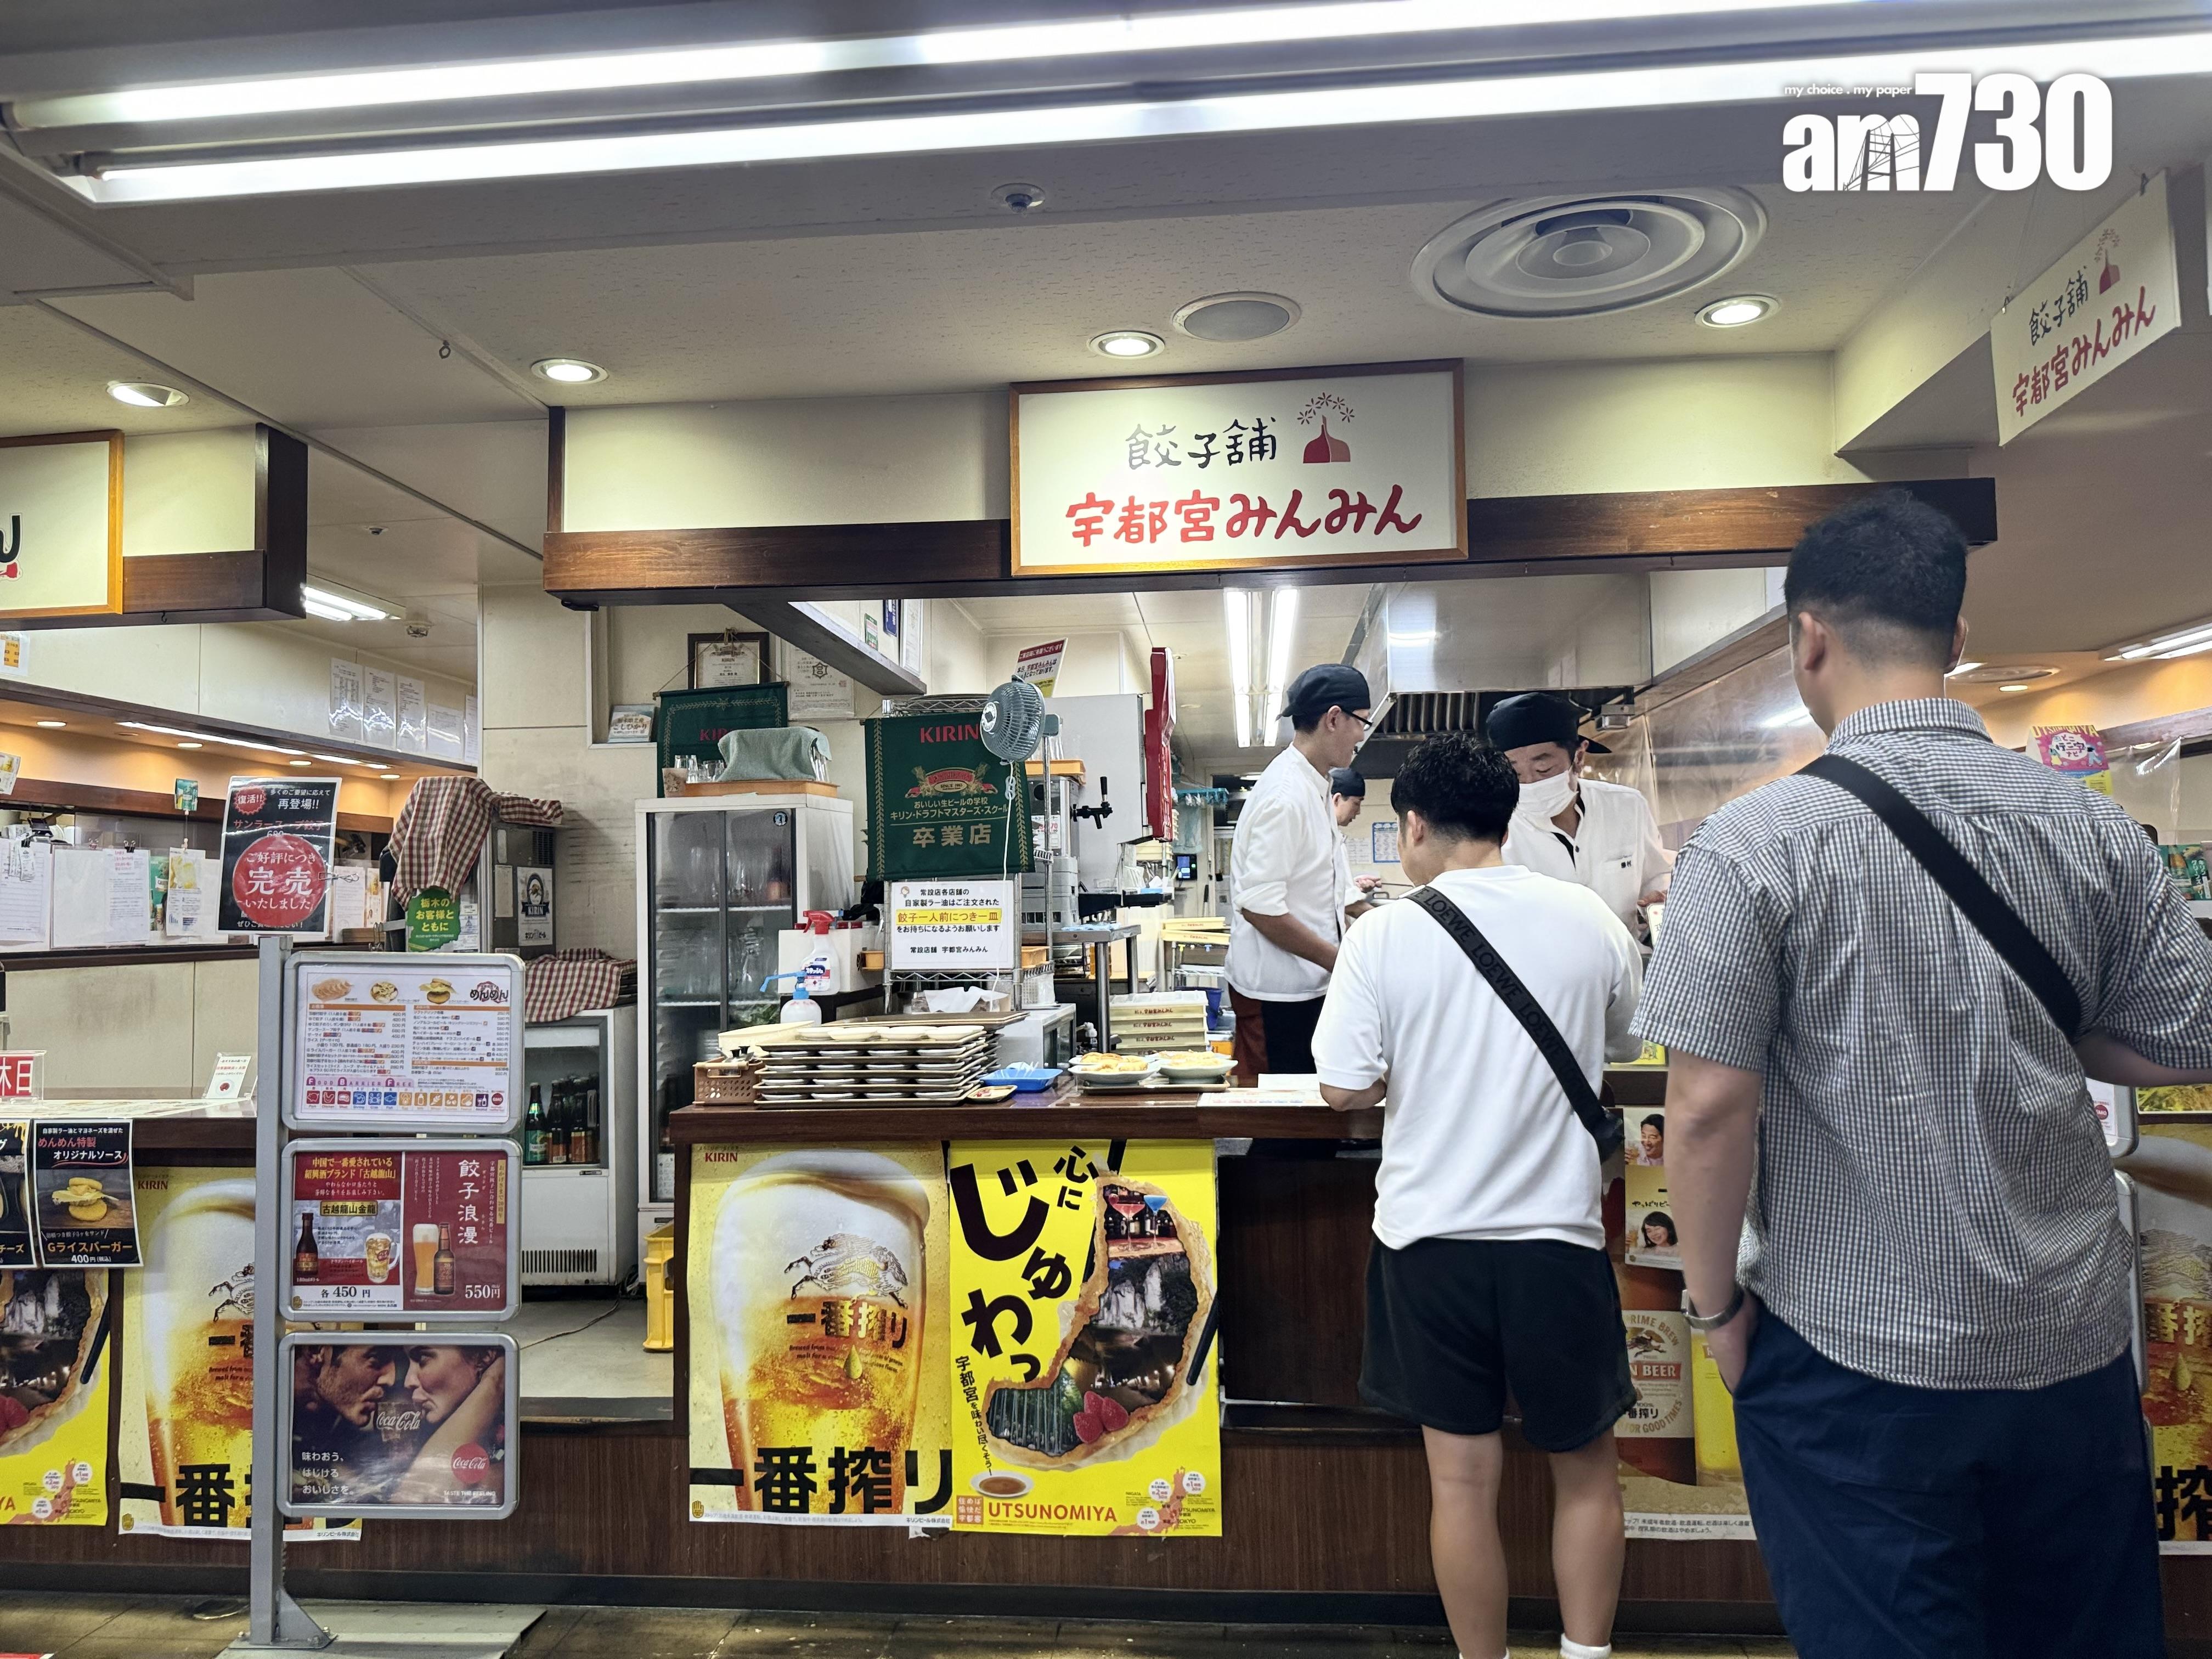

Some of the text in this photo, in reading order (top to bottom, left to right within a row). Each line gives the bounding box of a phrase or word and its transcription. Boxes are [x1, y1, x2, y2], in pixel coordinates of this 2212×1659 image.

[2012, 286, 2156, 417] 宇都宮みんみん
[1126, 416, 1278, 470] 餃子舗
[1065, 484, 1423, 547] 宇都宮みんみん
[700, 729, 729, 741] KIR
[920, 724, 980, 743] KIRIN
[238, 793, 263, 804] 復活!!
[278, 798, 320, 810] 再登場!!
[914, 797, 988, 809] おいしい生ビールの学校
[913, 823, 991, 849] 卒業店
[246, 853, 316, 865] ご好評につき
[246, 866, 313, 895] 完売
[246, 898, 311, 910] いたしました
[420, 898, 450, 908] 栃木の
[905, 899, 1000, 907] 自家製ラー油はご注文された
[415, 910, 455, 920] お客様と
[527, 906, 544, 915] KIRIN
[898, 912, 998, 923] 餃子一人前につき一皿
[1423, 894, 1477, 943] LOEWE
[421, 922, 449, 932] ともに
[897, 925, 1000, 933] をお持ちになるようお願いします
[1471, 944, 1523, 1002] LOEWE
[470, 989, 509, 1001] めんめん
[38, 1136, 97, 1148] めんめん特製
[53, 1150, 123, 1161] オリジナルソース
[705, 1152, 738, 1162] KIRIN
[312, 1157, 393, 1167] 中国で一番愛されている
[304, 1169, 396, 1180] 紹興酒ブランド「古越龍山」
[138, 1180, 168, 1189] KIRIN
[458, 1159, 480, 1244] 餃子浪漫
[323, 1204, 376, 1214] 古越龍山金龍
[47, 1241, 133, 1254] Gライスバーガー
[71, 1254, 96, 1263] 400円
[320, 1286, 371, 1298] 各 450 円
[465, 1284, 500, 1299] 550円
[787, 1300, 908, 1348] 一番搾り
[1630, 1314, 1680, 1346] RIME BREW
[1643, 1364, 1676, 1376] BEER
[1627, 1408, 1659, 1419] 番搾り
[1642, 1400, 1683, 1434] GOOD TIMES
[302, 1451, 345, 1462] 味わおう、
[302, 1468, 339, 1478] はじける
[690, 1446, 953, 1515] 一番搾り
[302, 1485, 354, 1494] おいしさを。
[988, 1502, 1118, 1522] UTSUNOMIYA
